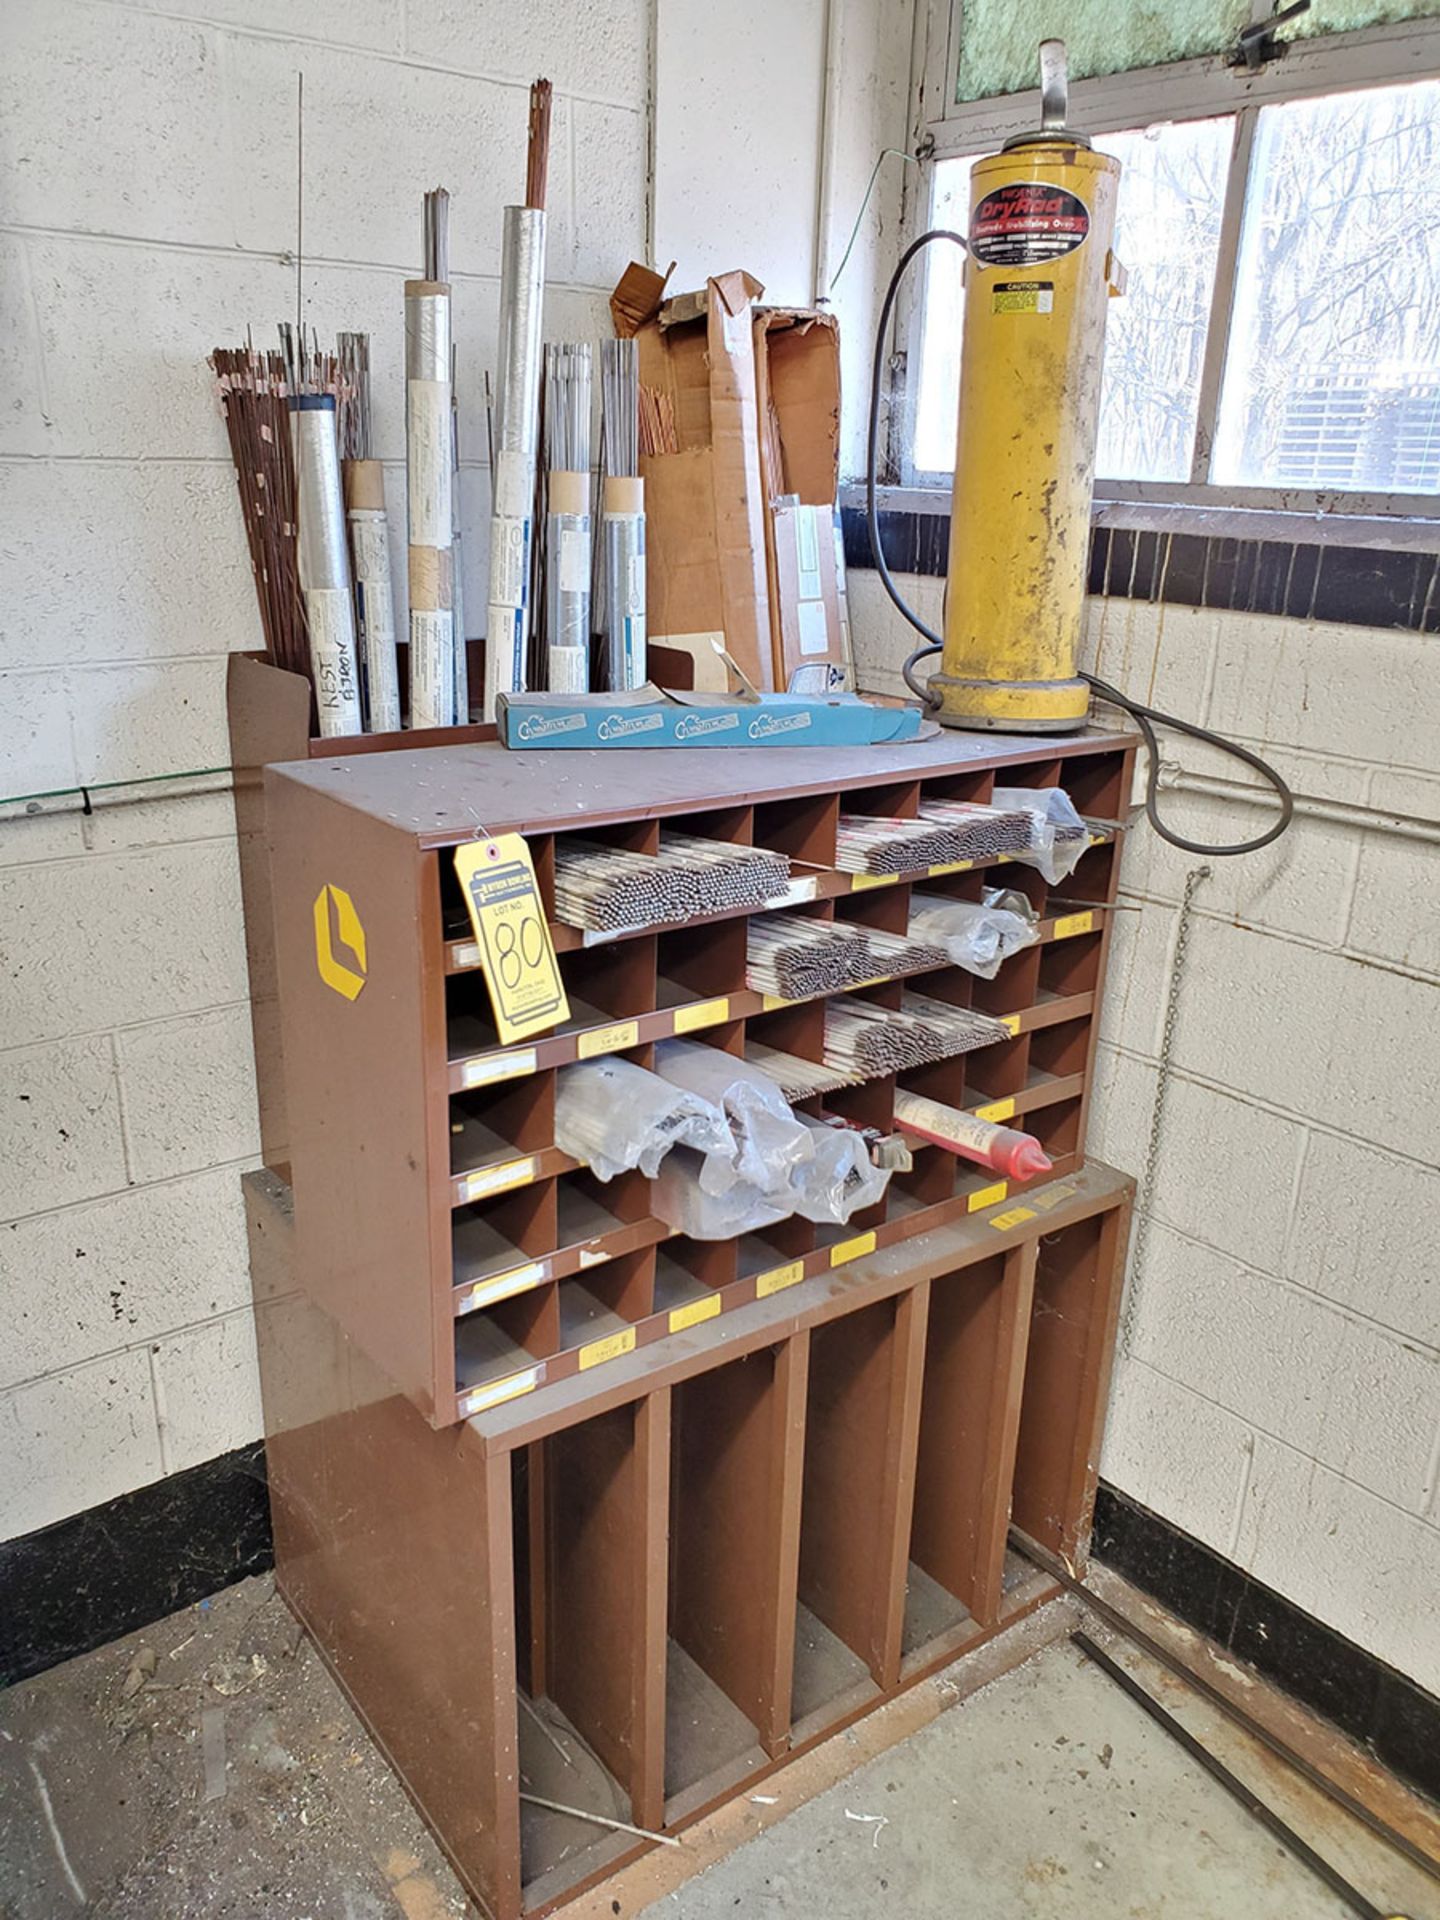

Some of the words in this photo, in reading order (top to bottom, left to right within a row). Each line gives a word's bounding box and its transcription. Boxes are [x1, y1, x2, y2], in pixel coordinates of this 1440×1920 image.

[980, 197, 1063, 219] DryRod
[1053, 219, 1075, 228] Oven
[1007, 282, 1039, 291] CAUTION
[493, 905, 511, 917] LOT
[495, 916, 544, 989] 80
